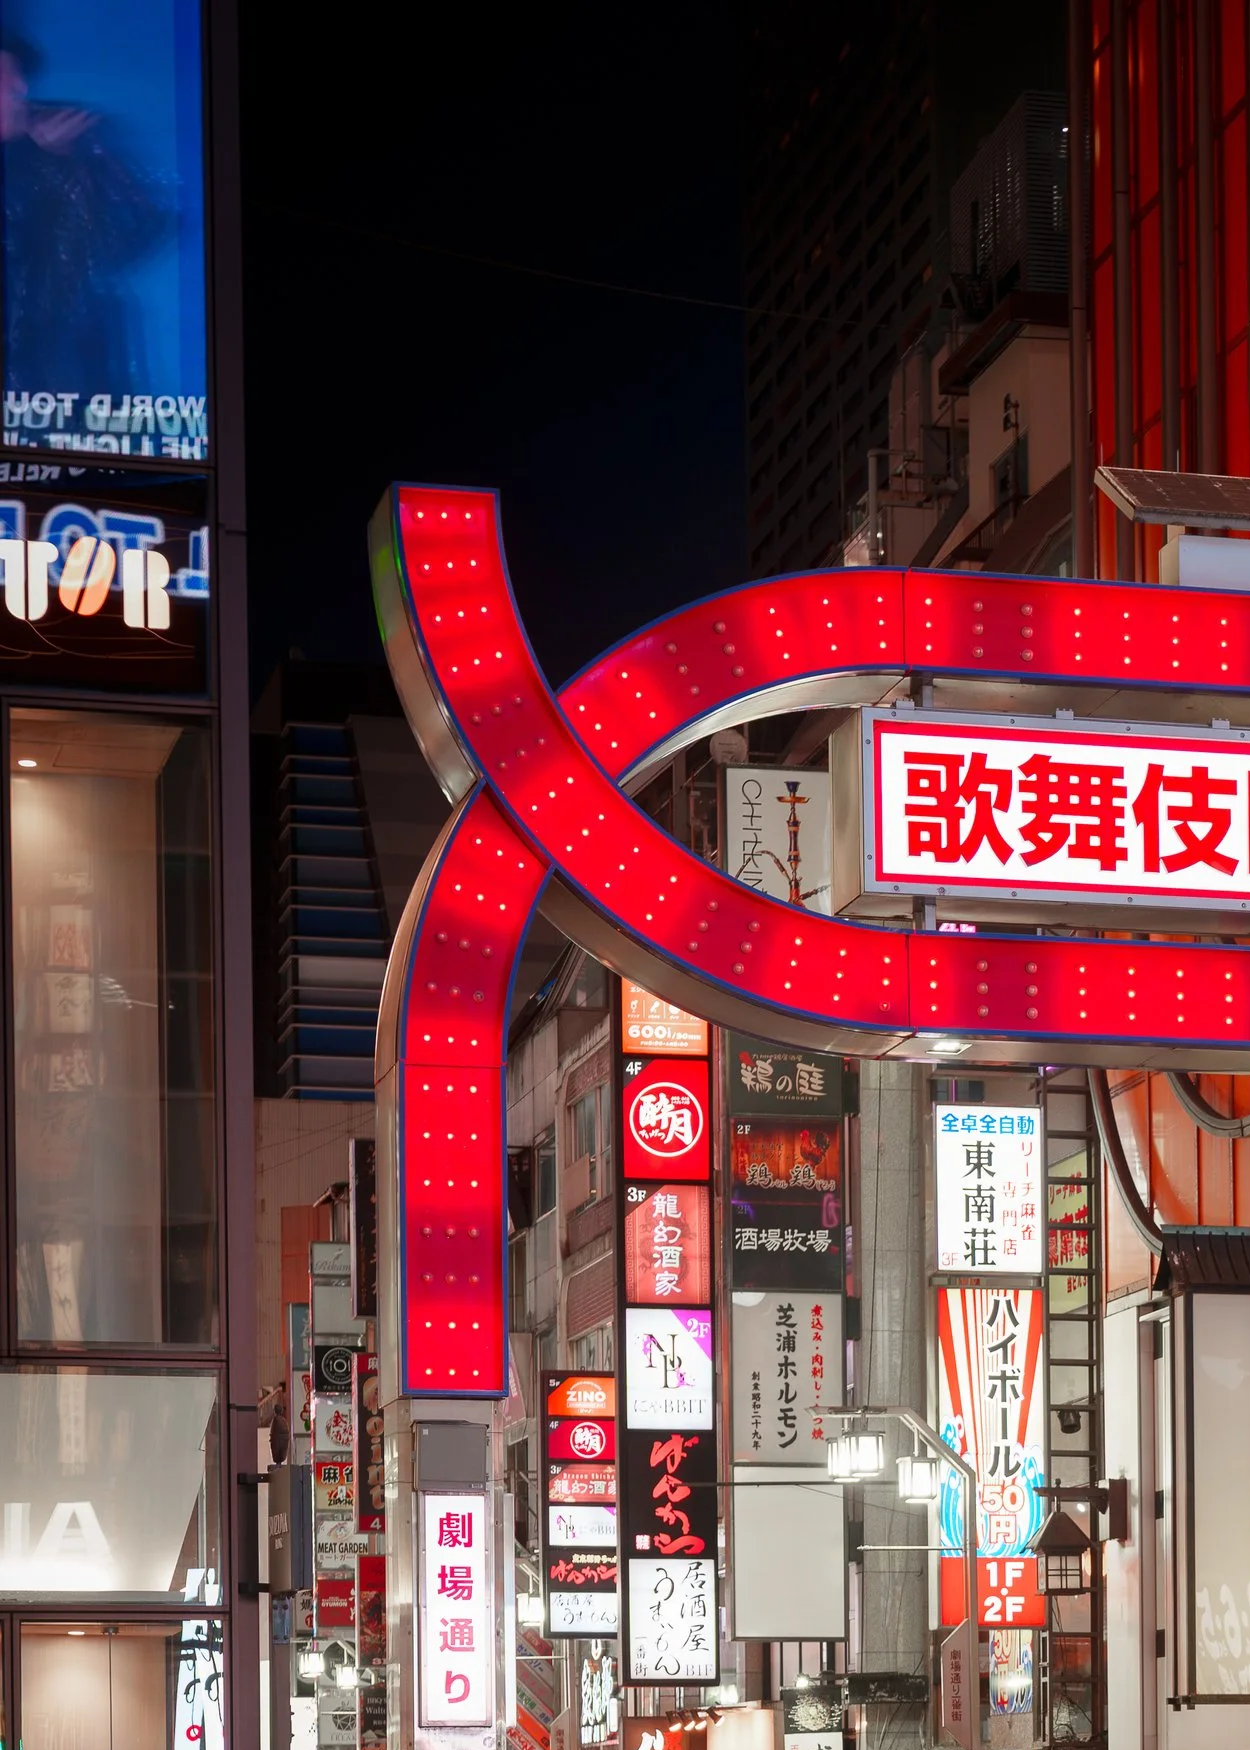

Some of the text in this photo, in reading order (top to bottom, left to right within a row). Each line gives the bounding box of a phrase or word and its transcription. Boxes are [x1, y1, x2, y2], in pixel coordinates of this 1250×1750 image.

[625, 1061, 642, 1076] 4F
[737, 1125, 751, 1135] 2F
[941, 1112, 1035, 1135] 全卓全自動
[627, 1187, 647, 1202] 3F
[962, 1140, 997, 1267] 東南荘
[1020, 1141, 1037, 1241] リーチ麻雀
[1002, 1181, 1018, 1256] 専門店
[652, 1193, 684, 1296] 龍幻酒家
[734, 1227, 832, 1253] 酒場牧場
[941, 1251, 959, 1266] 3F
[686, 1317, 711, 1338] 2F
[775, 1302, 798, 1449] 芝浦ホルモン
[811, 1304, 825, 1441] 煮込み・肉刺し・つ焼
[566, 1391, 607, 1402] ZINO
[986, 1298, 1022, 1478] ハイボール
[751, 1370, 762, 1451] 創業昭和二十九年
[549, 1420, 560, 1430] 4F
[550, 1465, 562, 1475] 3F
[318, 1542, 368, 1554] MEAT GARDEN
[985, 1561, 1025, 1588] 1F
[437, 1511, 476, 1704] 劇場通り
[679, 1561, 710, 1652] 居酒屋
[984, 1596, 1025, 1622] 2F
[950, 1649, 963, 1723] 劇場通り一番街
